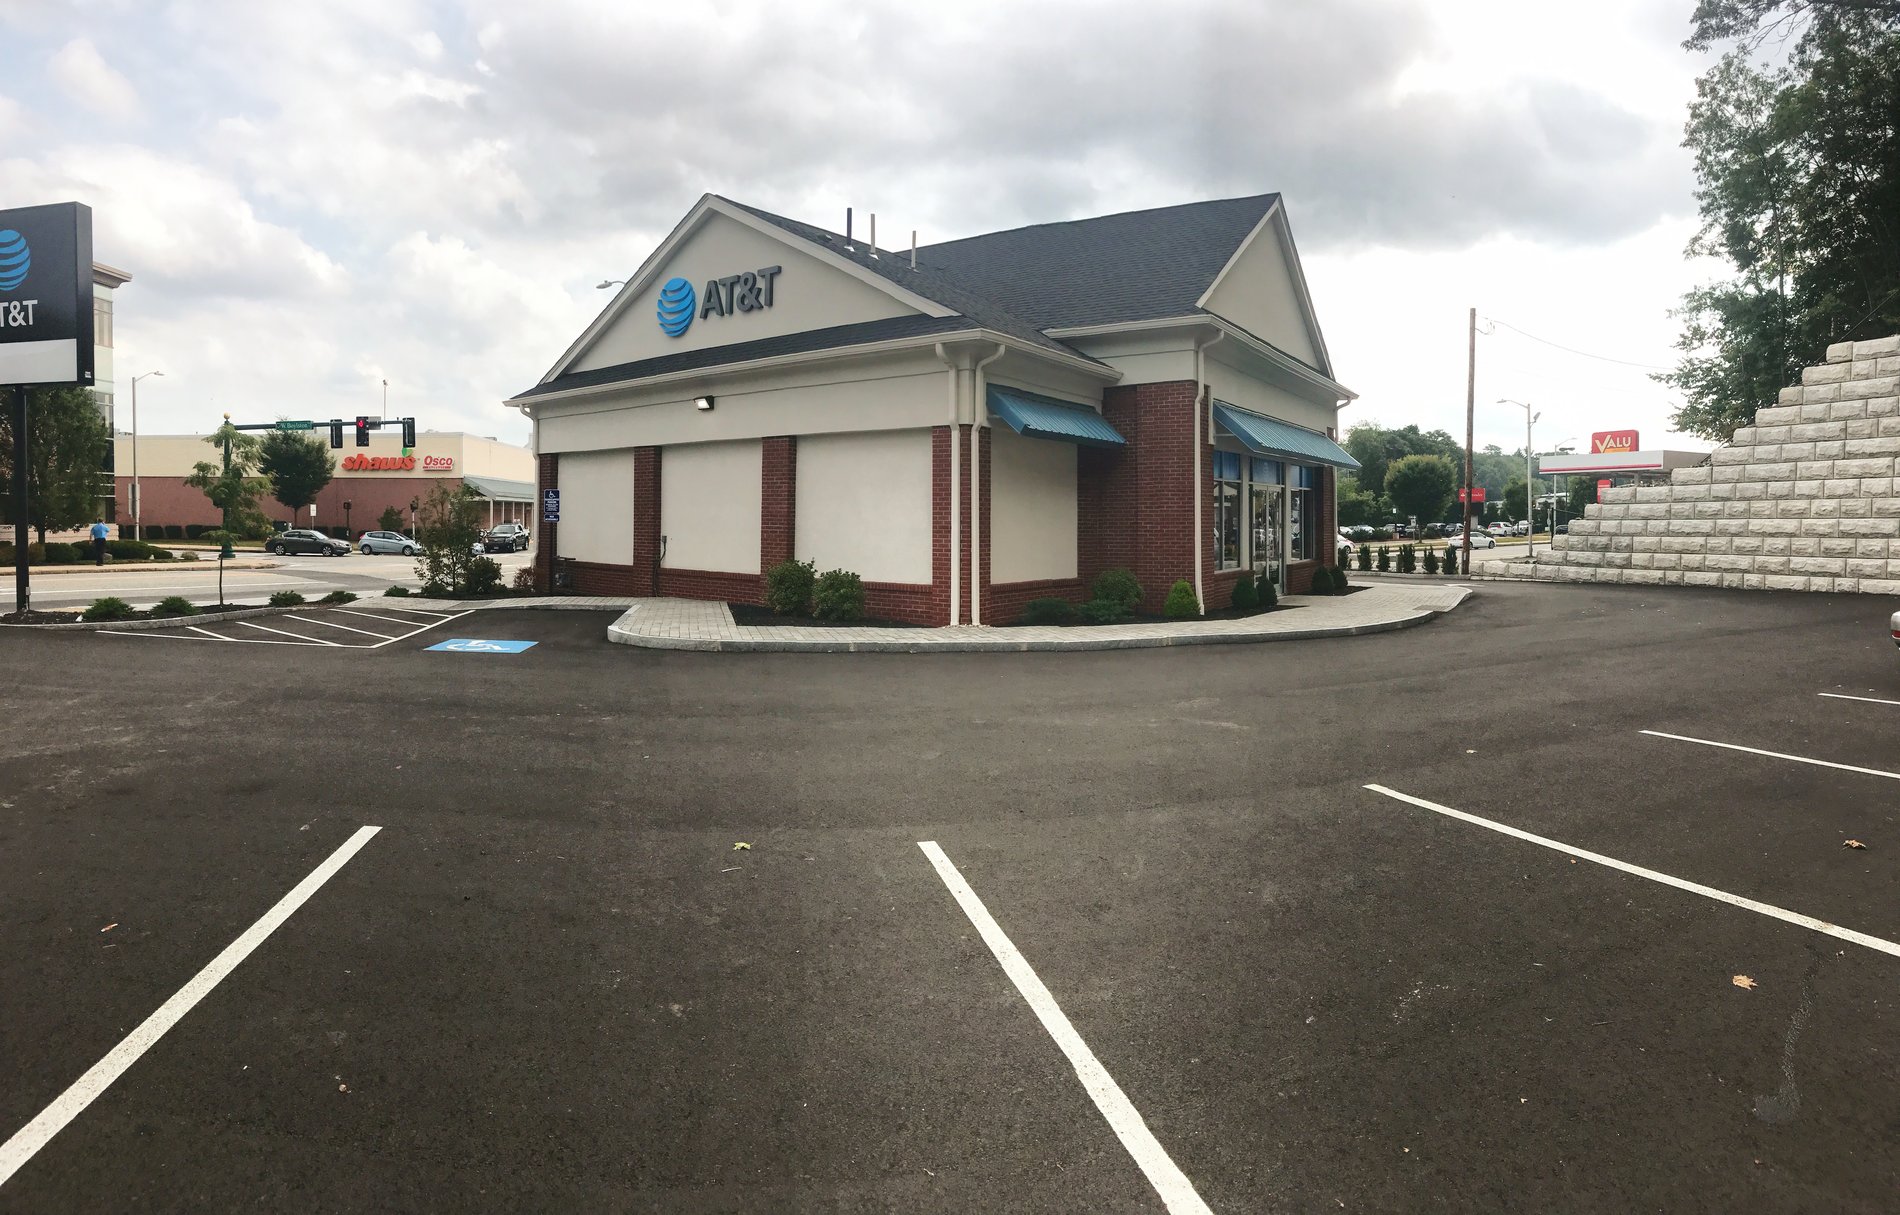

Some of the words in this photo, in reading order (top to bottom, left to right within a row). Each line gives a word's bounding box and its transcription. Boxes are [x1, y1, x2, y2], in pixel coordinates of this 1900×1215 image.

[700, 265, 782, 320] AT&T
[1595, 434, 1631, 453] VALU
[424, 455, 453, 466] Osco
